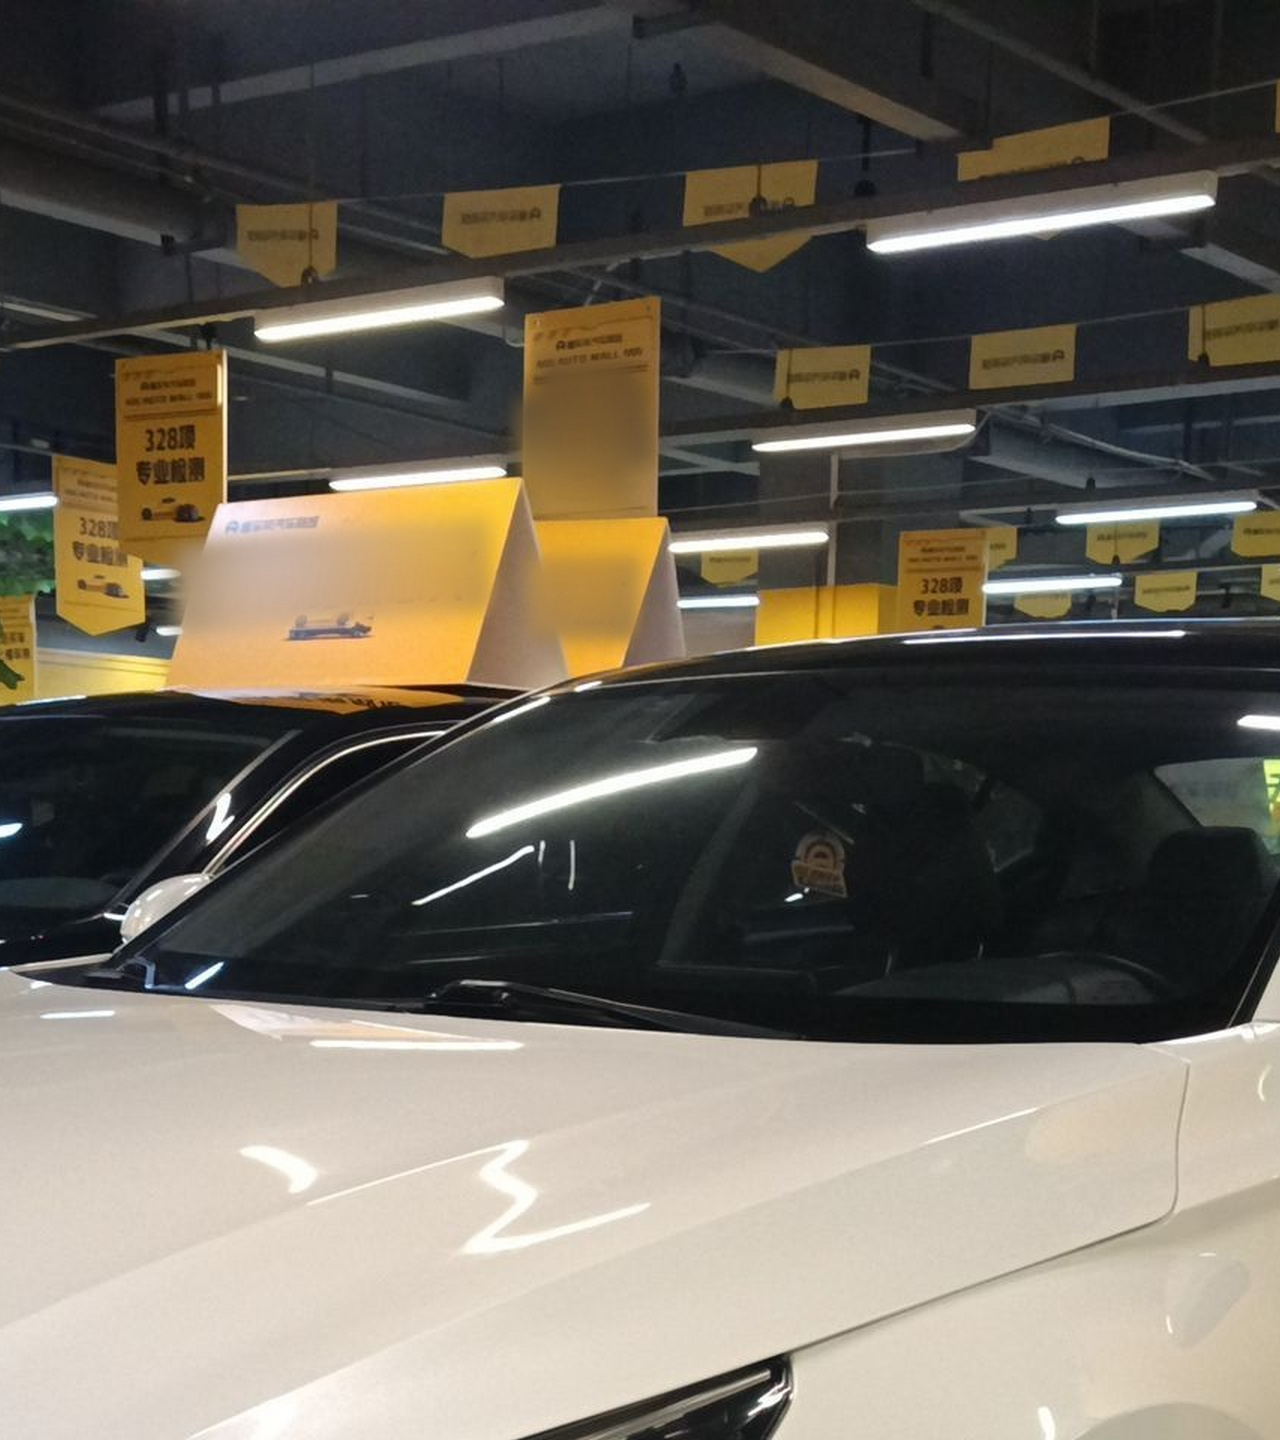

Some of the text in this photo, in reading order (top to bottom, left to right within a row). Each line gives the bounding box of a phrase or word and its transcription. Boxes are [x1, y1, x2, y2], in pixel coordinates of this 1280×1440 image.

[144, 425, 196, 452] 328项
[136, 457, 206, 486] 专业检测
[921, 576, 963, 594] 328项
